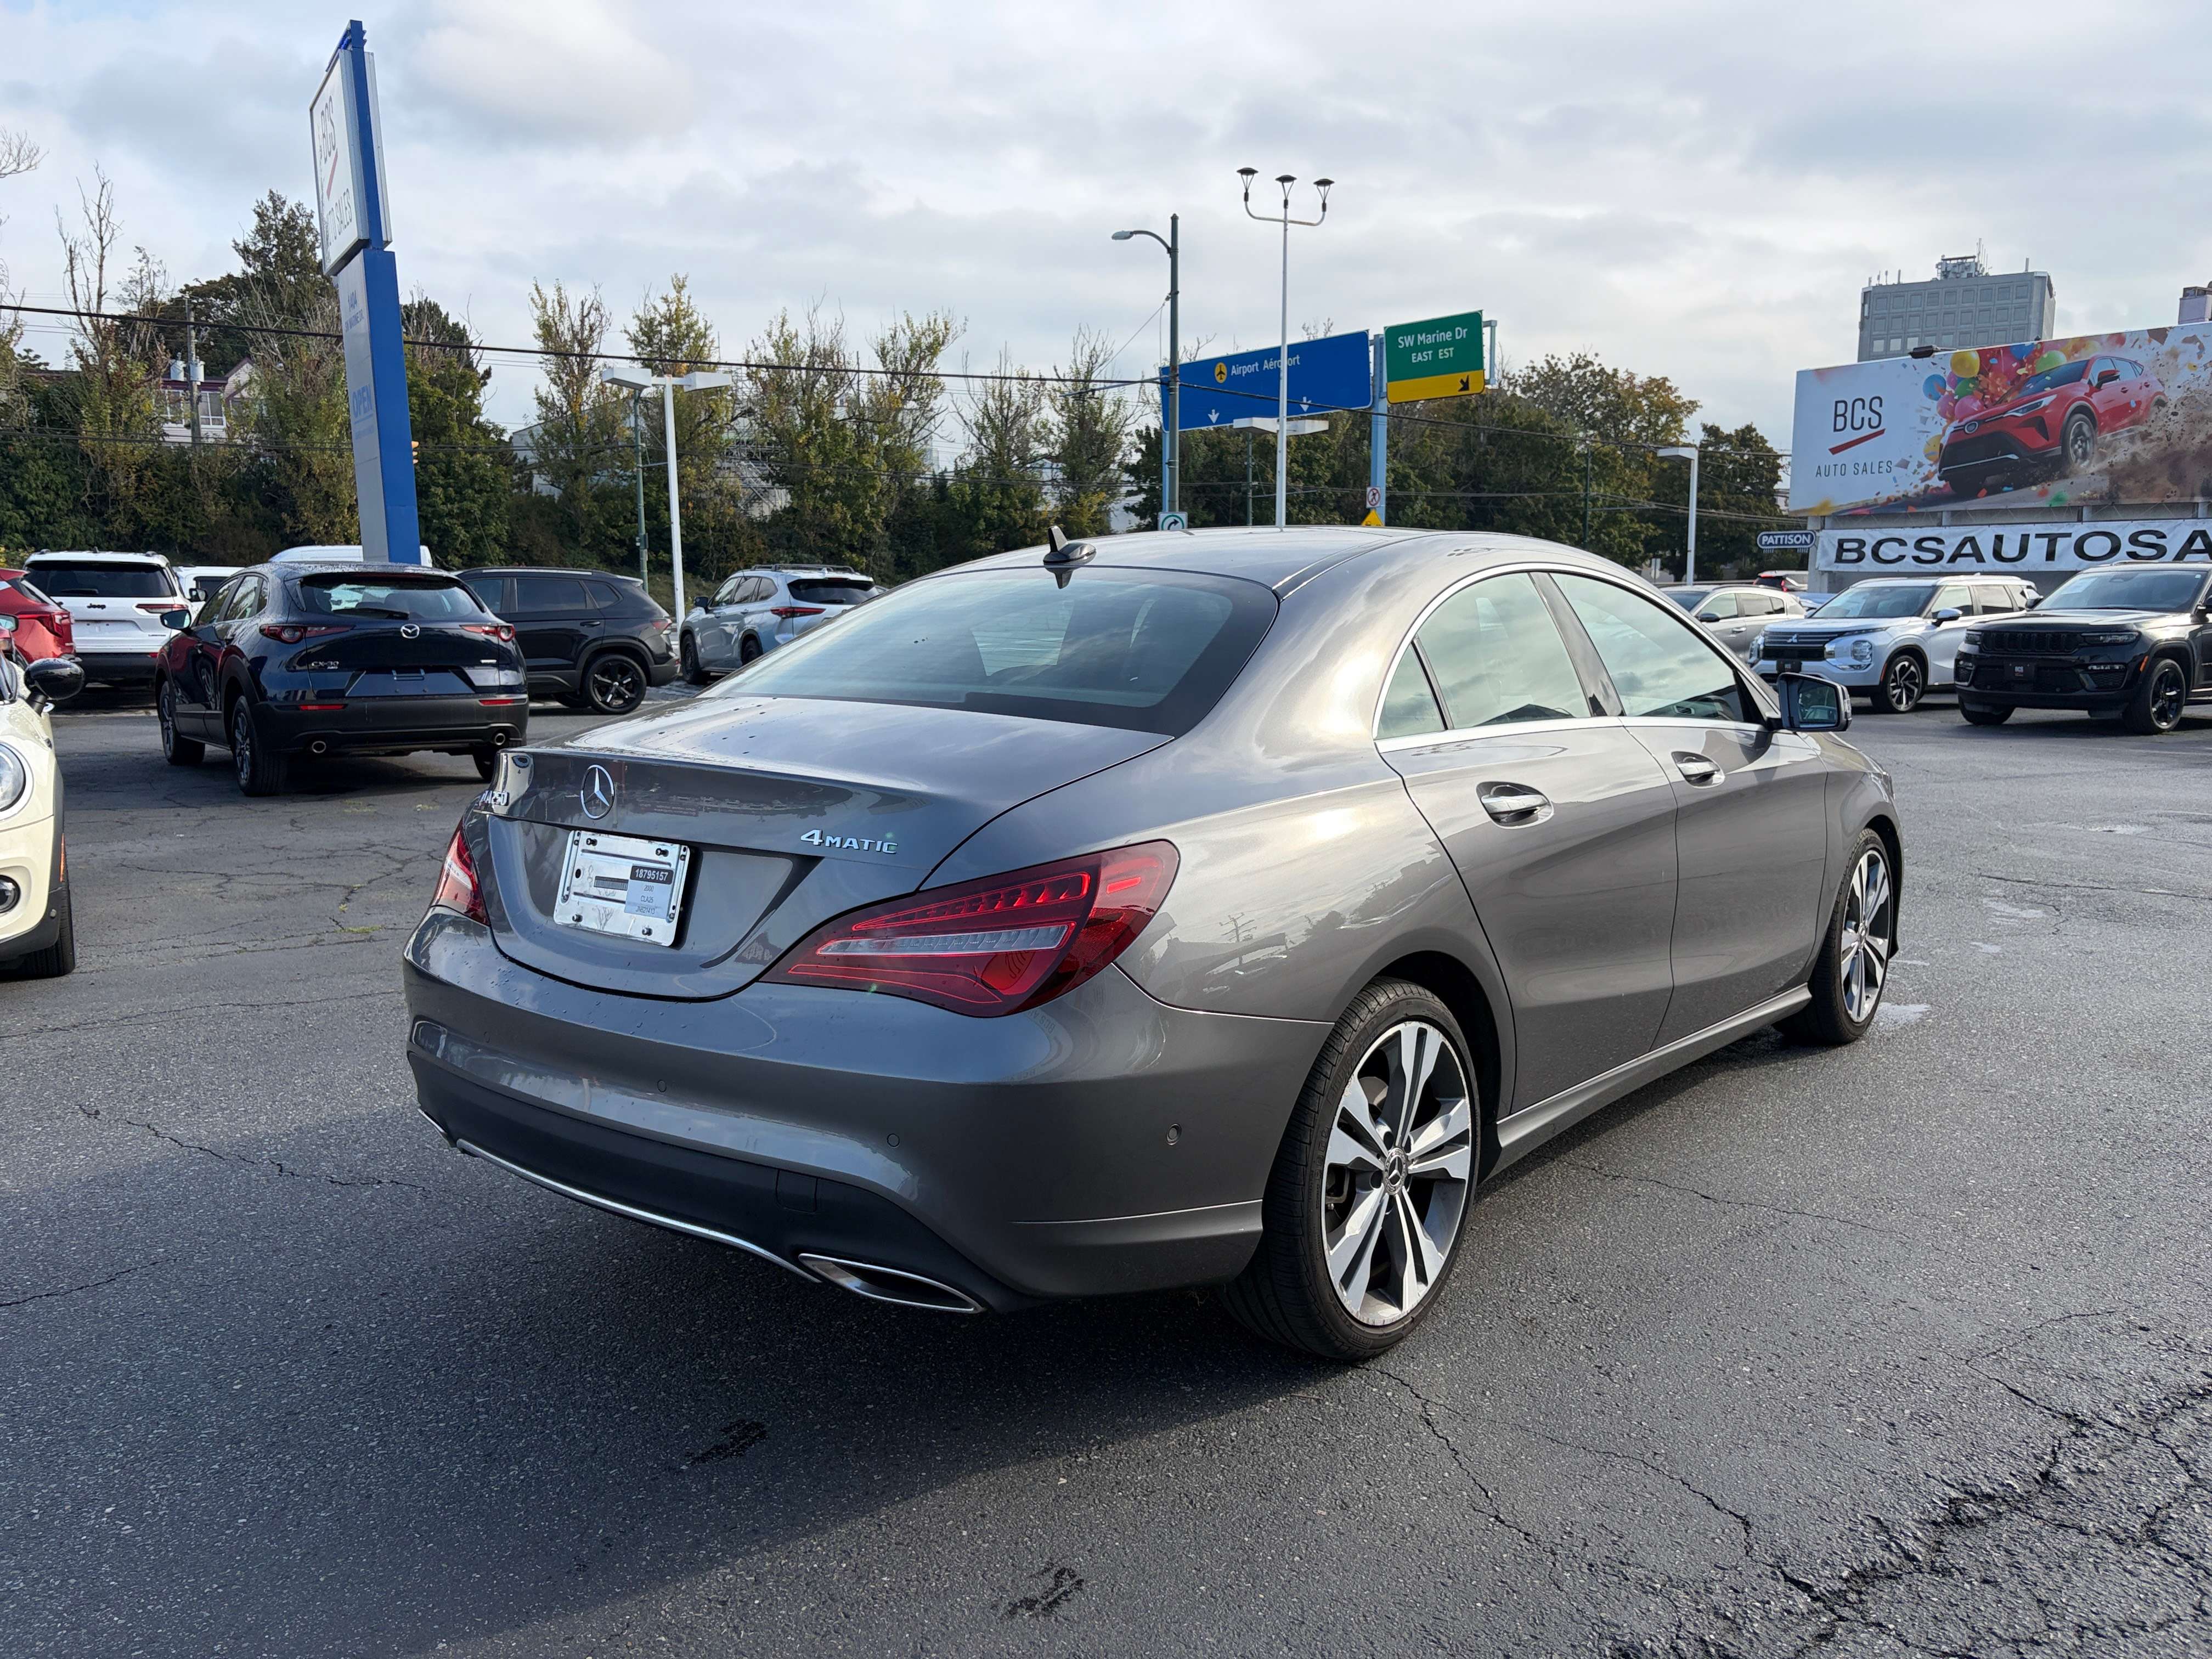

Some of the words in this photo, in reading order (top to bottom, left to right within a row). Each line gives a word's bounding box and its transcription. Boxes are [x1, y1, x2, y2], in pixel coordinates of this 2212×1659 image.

[320, 95, 336, 165] BCS
[335, 188, 353, 236] SALES
[1398, 334, 1415, 348] SW
[1417, 330, 1452, 346] Marine
[1455, 326, 1468, 340] Dr
[1231, 362, 1259, 377] Airport
[1262, 354, 1301, 371] Aéroort
[1411, 351, 1433, 363] EAST
[1438, 347, 1454, 359] EST
[352, 384, 373, 419] OPEN
[1833, 396, 1883, 432] BCS
[1815, 463, 1847, 478] AUTO
[1853, 460, 1893, 476] SALES
[1762, 534, 1811, 545] PATTISON
[635, 868, 669, 881] 18795157
